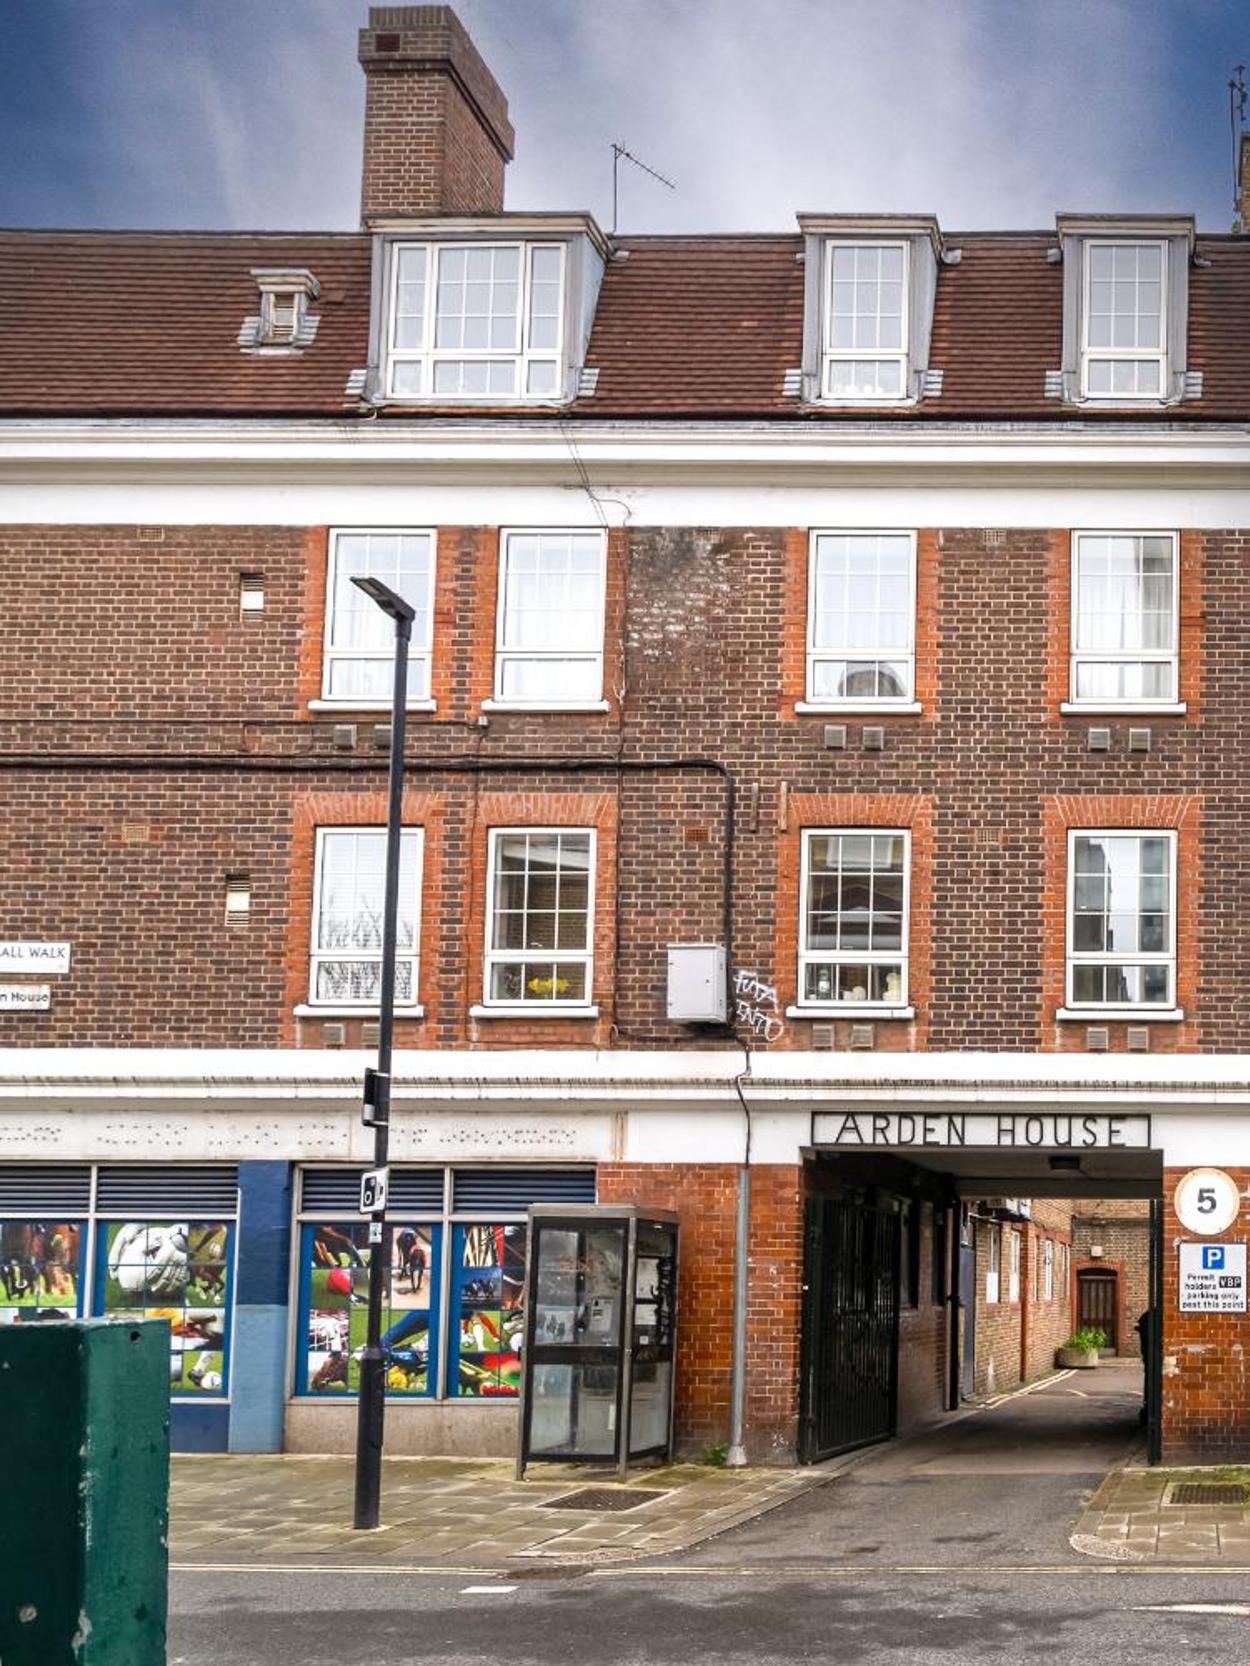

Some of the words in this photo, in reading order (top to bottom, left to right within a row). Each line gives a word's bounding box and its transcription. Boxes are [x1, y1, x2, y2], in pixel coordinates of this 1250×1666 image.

[0, 946, 23, 958] ALL
[29, 946, 66, 958] WALK
[11, 992, 49, 1002] House
[835, 1114, 966, 1145] ARDEN
[998, 1115, 1126, 1147] HOUSE
[1197, 1188, 1217, 1213] 5
[1207, 1249, 1221, 1267] P
[1184, 1282, 1217, 1290] holders
[1220, 1277, 1241, 1287] VBP
[1187, 1291, 1219, 1301] parking
[1203, 1301, 1219, 1309] this
[1222, 1301, 1244, 1309] point
